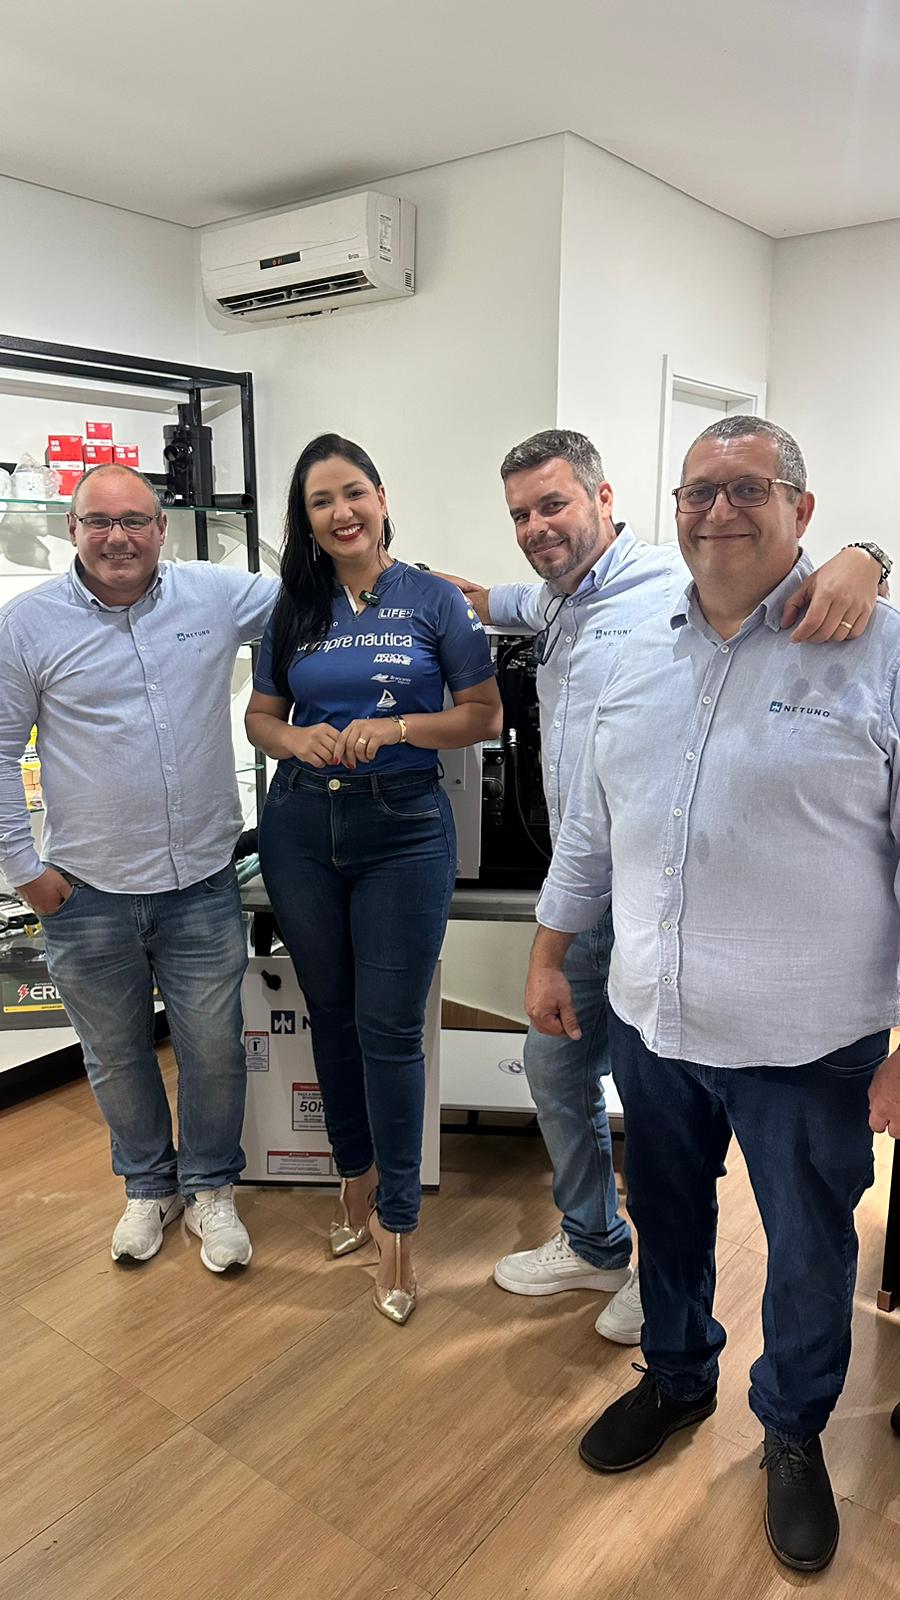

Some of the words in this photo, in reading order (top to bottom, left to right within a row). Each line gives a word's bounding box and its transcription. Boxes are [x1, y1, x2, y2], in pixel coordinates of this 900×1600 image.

[185, 629, 210, 639] NETUNO
[297, 635, 353, 653] mpre
[355, 632, 413, 648] náutica
[783, 704, 830, 718] NETUNO
